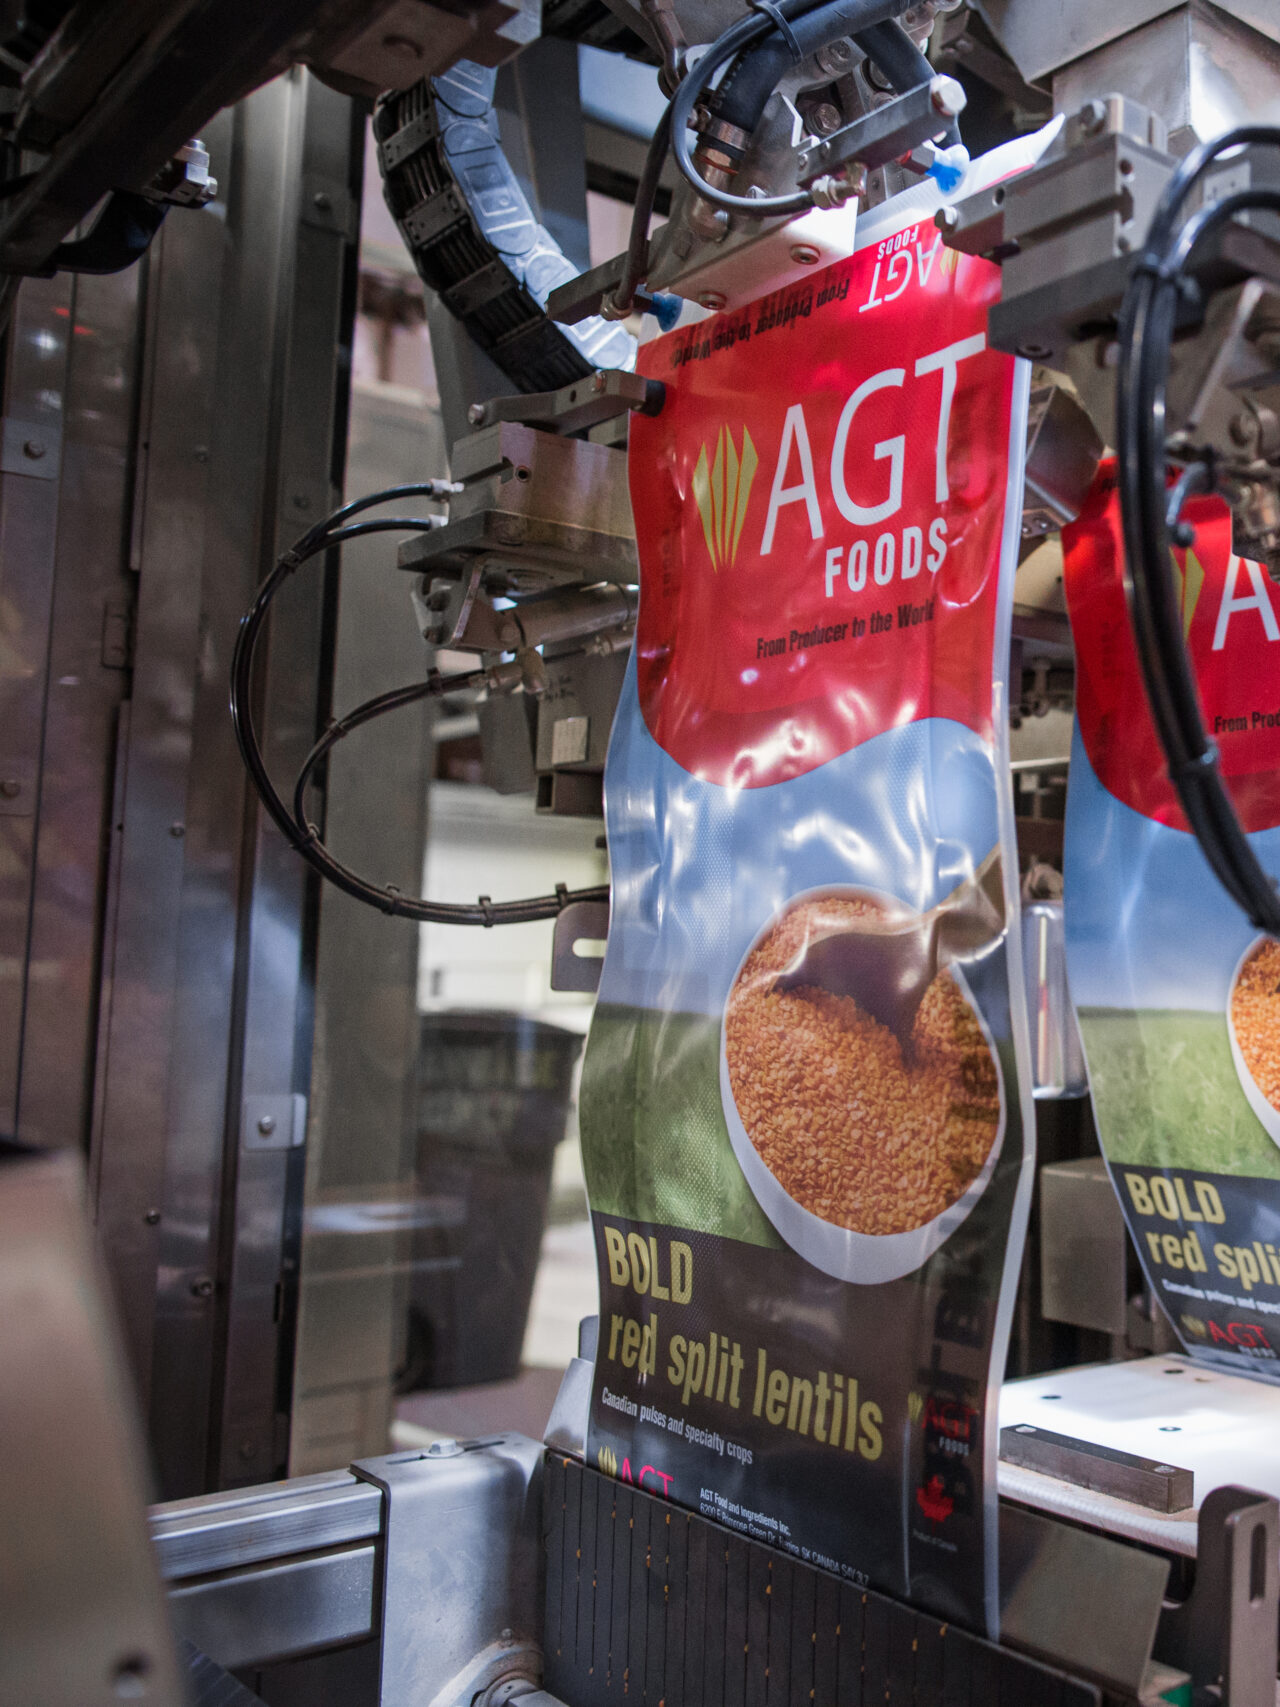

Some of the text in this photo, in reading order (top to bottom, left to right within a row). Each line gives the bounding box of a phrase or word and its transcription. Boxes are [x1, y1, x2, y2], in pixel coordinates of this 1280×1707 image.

[878, 225, 919, 259] FOODS
[816, 279, 850, 308] From
[859, 232, 941, 313] AGT
[714, 329, 736, 350] the
[738, 323, 751, 341] to
[760, 332, 986, 556] AGT
[825, 517, 948, 598] FOODS
[756, 597, 936, 659] From Producer to the World
[1214, 716, 1247, 734] From
[1124, 1172, 1226, 1224] BOLD
[604, 1226, 693, 1305] BOLD
[1145, 1230, 1207, 1272] red
[1208, 1320, 1270, 1348] AGT
[608, 1313, 883, 1461] red split lentils
[602, 1386, 753, 1465] Canadian pulses and specialty crops
[922, 1396, 979, 1439] AGT
[700, 1487, 713, 1502] AGT
[714, 1492, 728, 1509] Food
[728, 1502, 740, 1515] and
[740, 1505, 778, 1530] Ingredients
[749, 1523, 767, 1540] Green
[812, 1551, 839, 1572] CANADA
